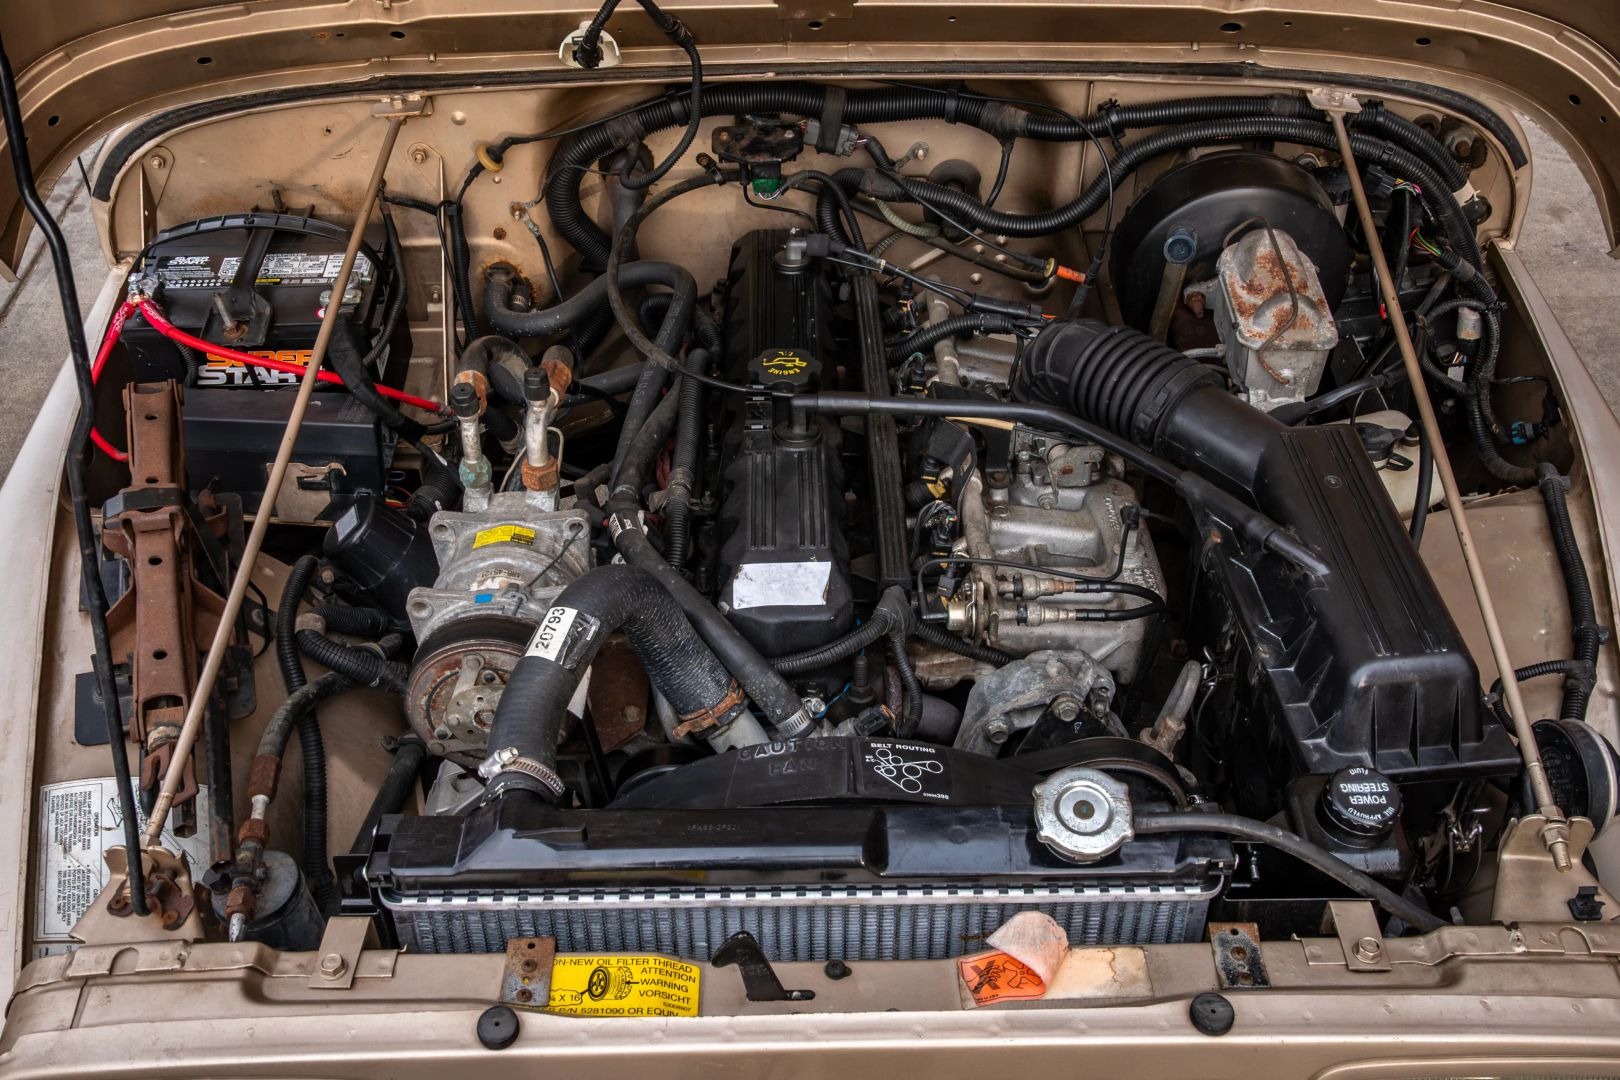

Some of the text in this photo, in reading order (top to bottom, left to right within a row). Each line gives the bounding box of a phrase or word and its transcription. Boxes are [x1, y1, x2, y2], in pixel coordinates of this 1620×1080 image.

[197, 364, 322, 385] STAR
[535, 608, 566, 650] 20793
[896, 744, 936, 753] ROUTING
[1340, 782, 1389, 792] STEERING
[1349, 795, 1386, 804] POWER
[1348, 806, 1395, 820] USE APPROVED
[653, 958, 692, 974] THREAD
[640, 967, 696, 983] ATTENTION
[640, 978, 688, 993] WARNING
[639, 990, 691, 1004] VORSICHT
